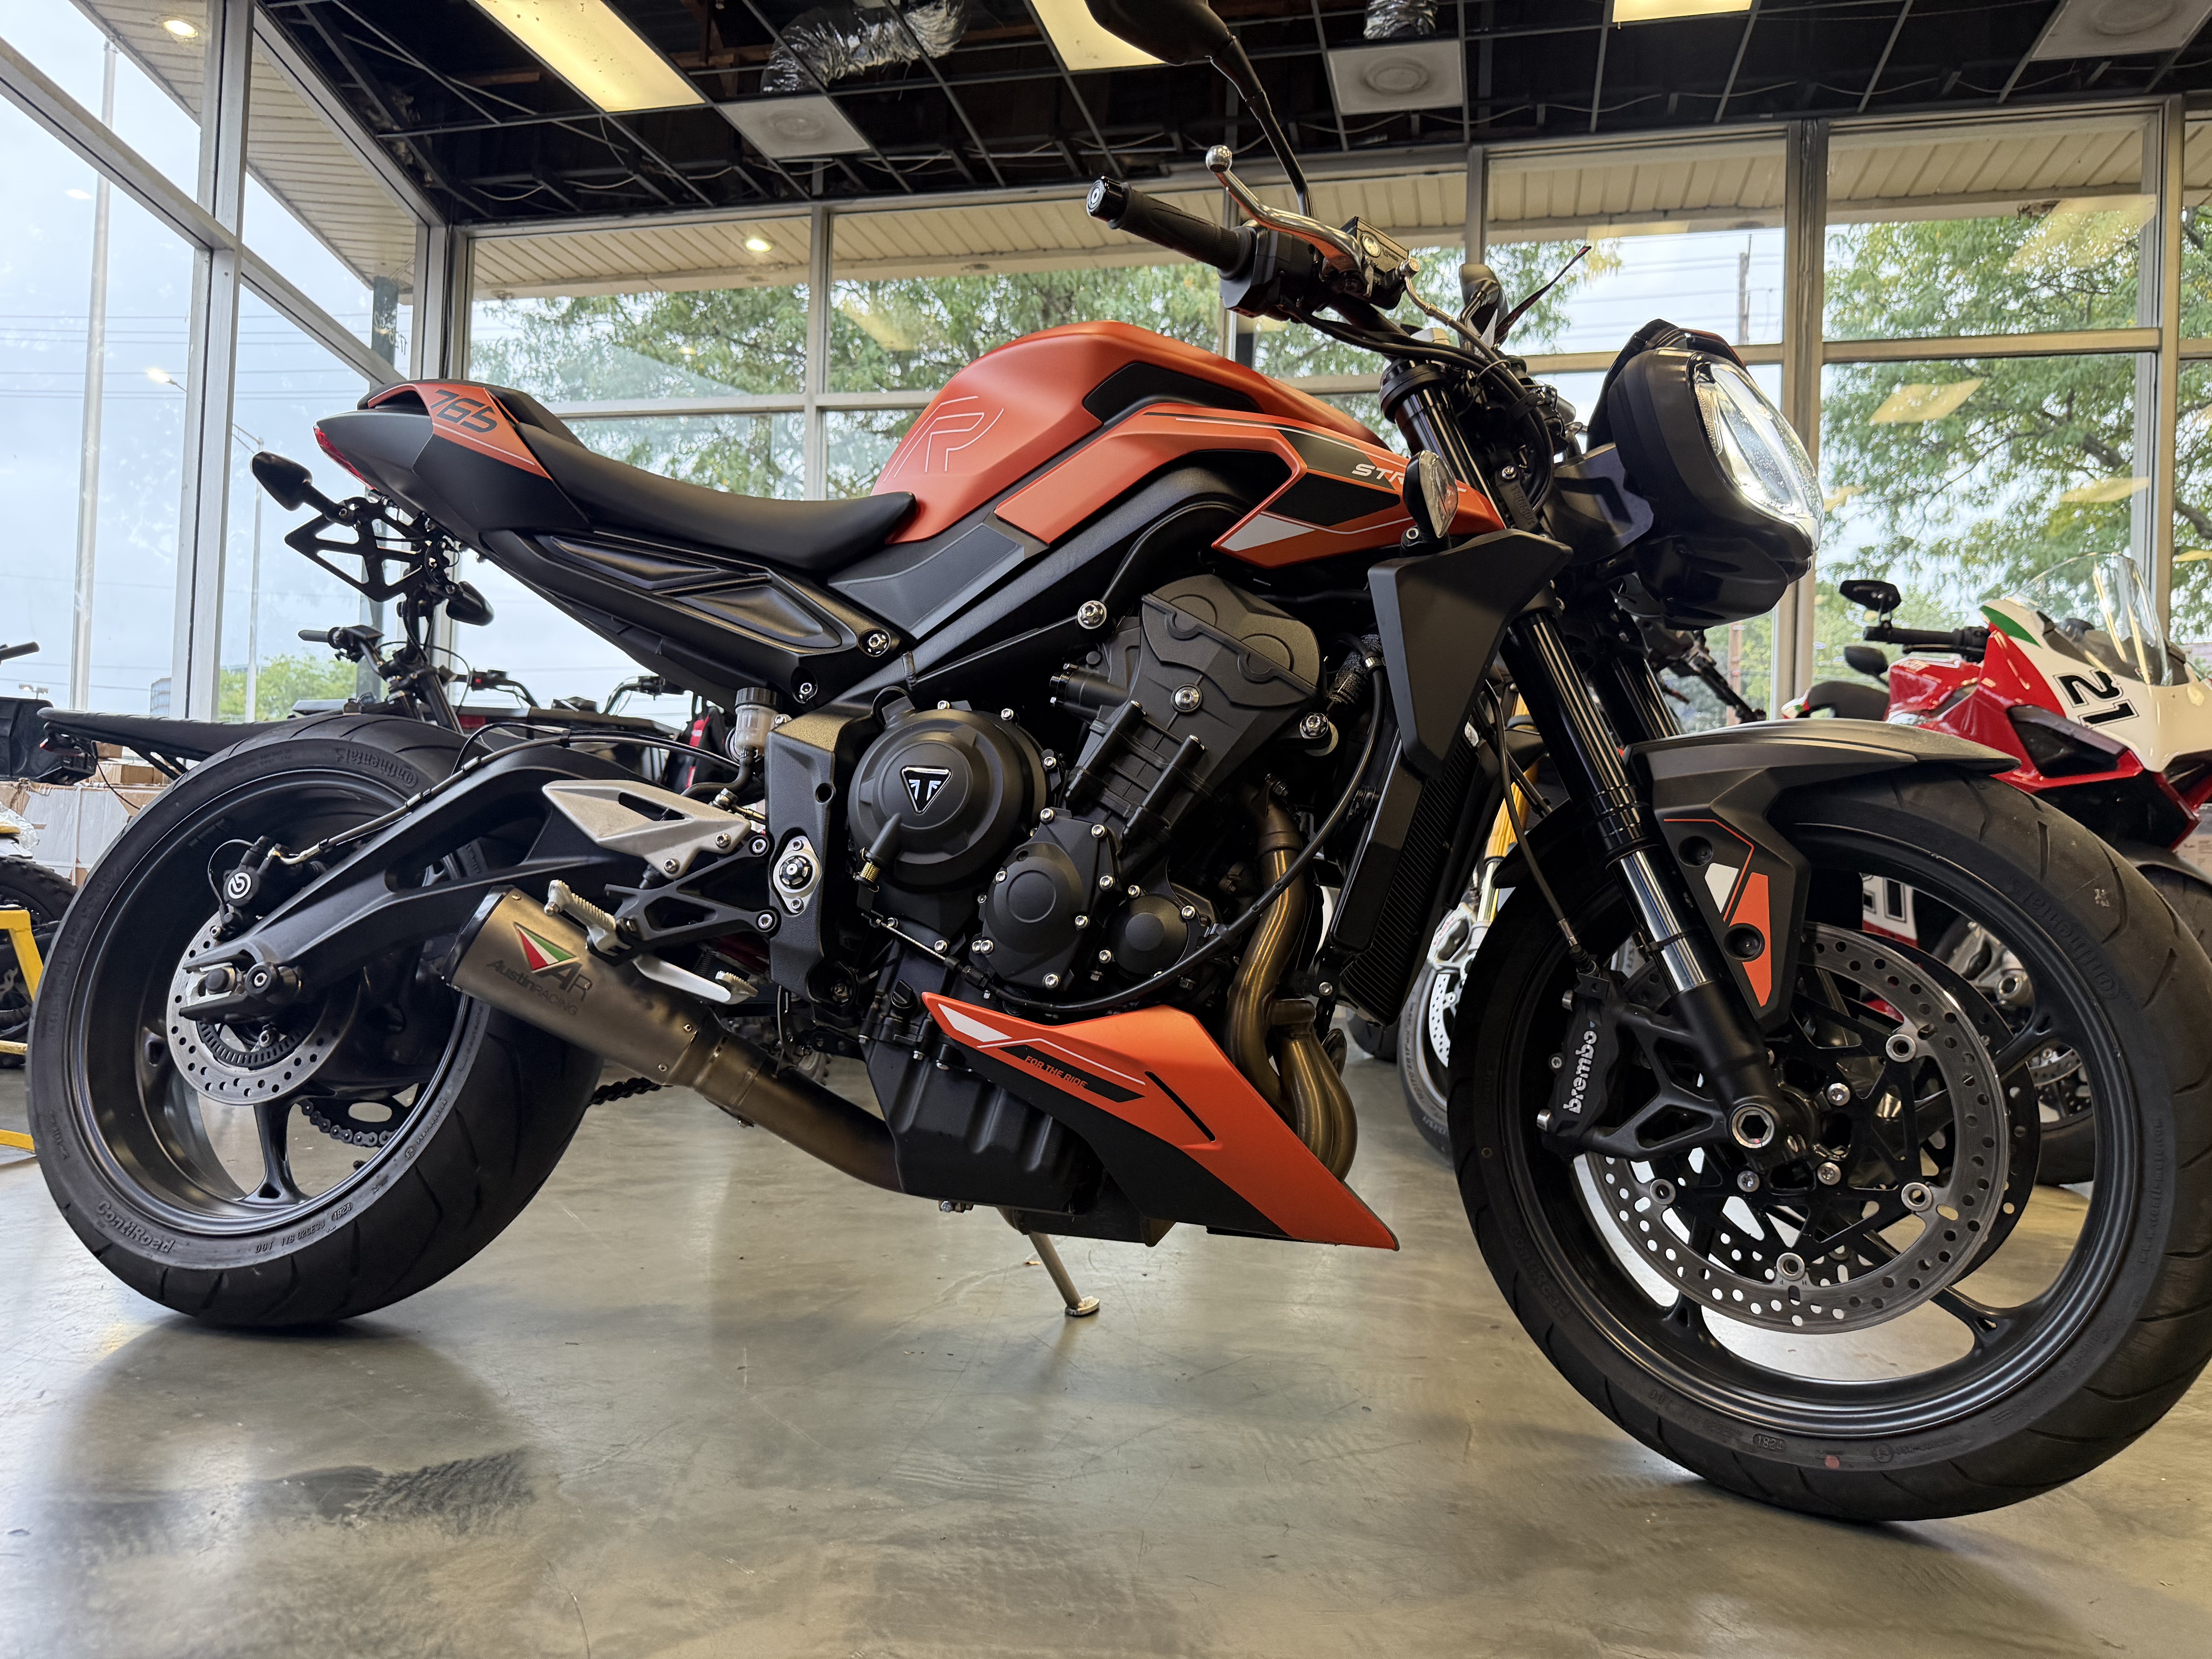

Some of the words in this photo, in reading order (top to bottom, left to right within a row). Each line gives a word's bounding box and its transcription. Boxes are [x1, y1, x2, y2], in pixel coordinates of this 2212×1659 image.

[430, 389, 498, 433] 765
[2052, 668, 2140, 729] 21
[1025, 1056, 1045, 1070] FOR
[1045, 1064, 1064, 1079] THE
[1063, 1073, 1088, 1088] RIDE
[1563, 1030, 1597, 1114] brembo
[97, 1200, 175, 1253] ContiRoad
[332, 1203, 352, 1221] 1924
